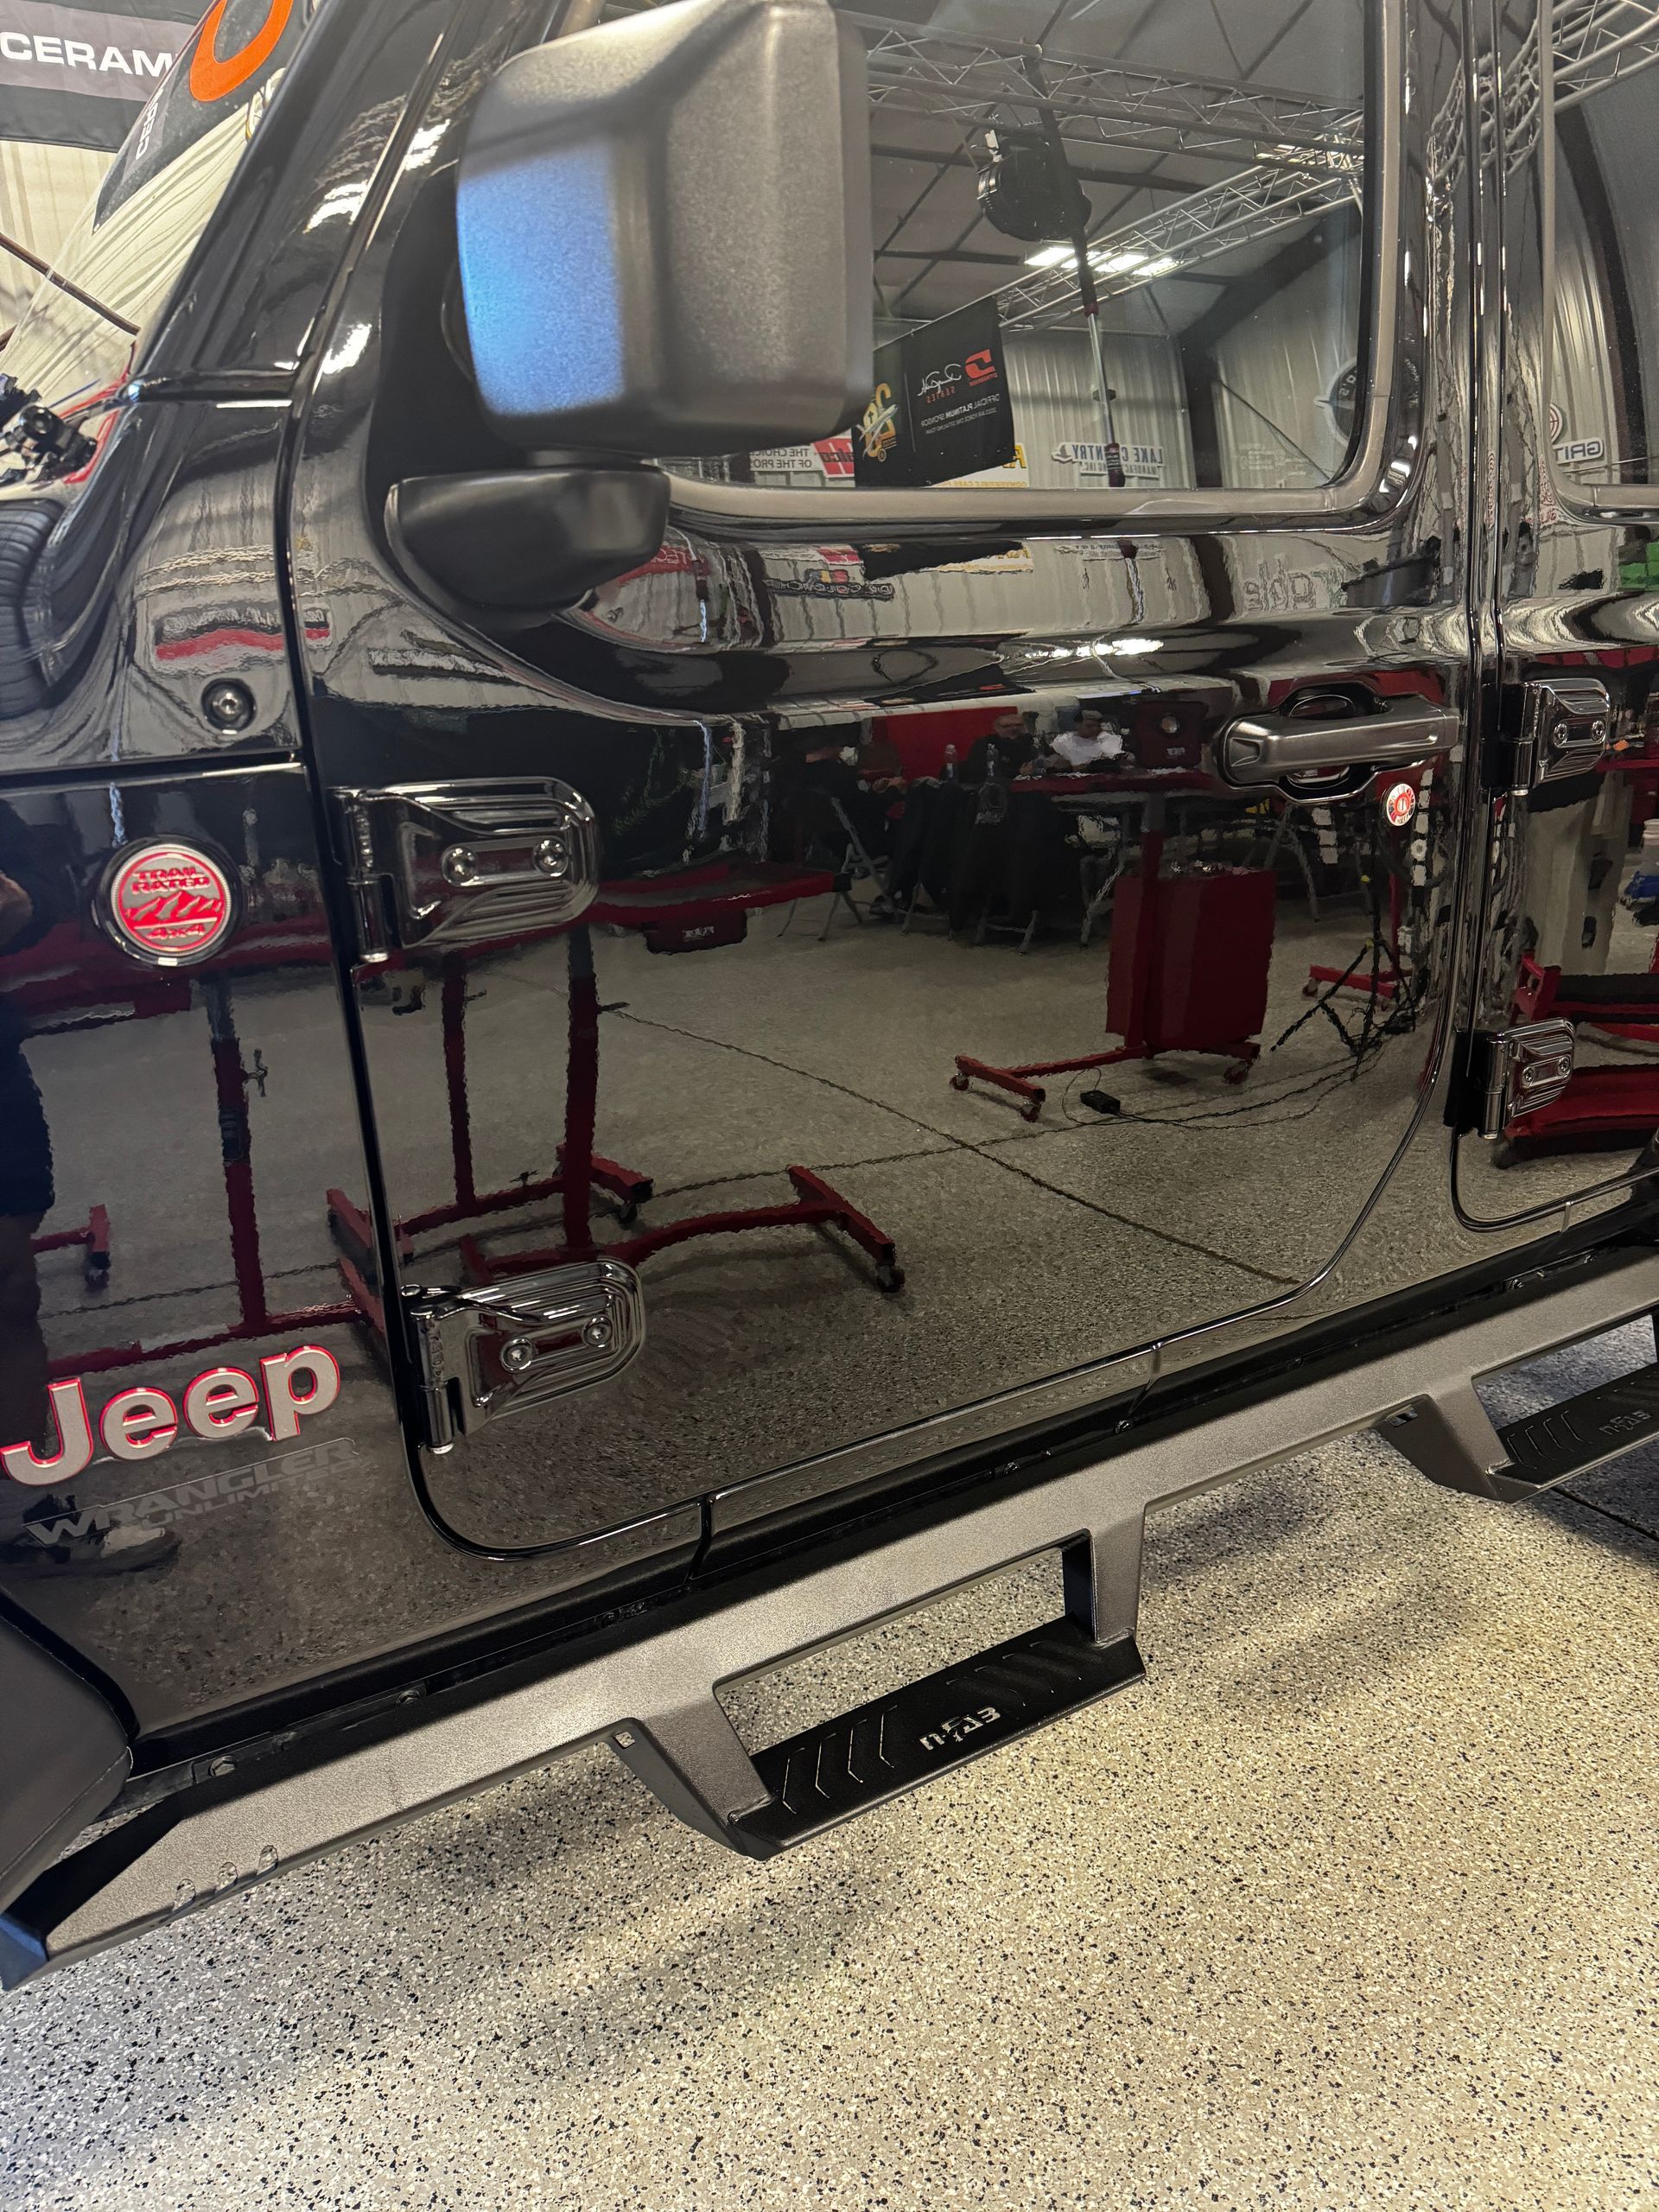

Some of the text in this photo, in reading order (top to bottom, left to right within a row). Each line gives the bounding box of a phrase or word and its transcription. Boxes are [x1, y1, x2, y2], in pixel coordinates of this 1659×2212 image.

[0, 31, 175, 79] CERAM
[131, 876, 211, 895] RATED
[132, 867, 205, 881] TRAIL
[1, 1344, 340, 1486] Jeep
[24, 1441, 349, 1547] WRANGLER
[142, 1459, 360, 1527] UNLIMITED
